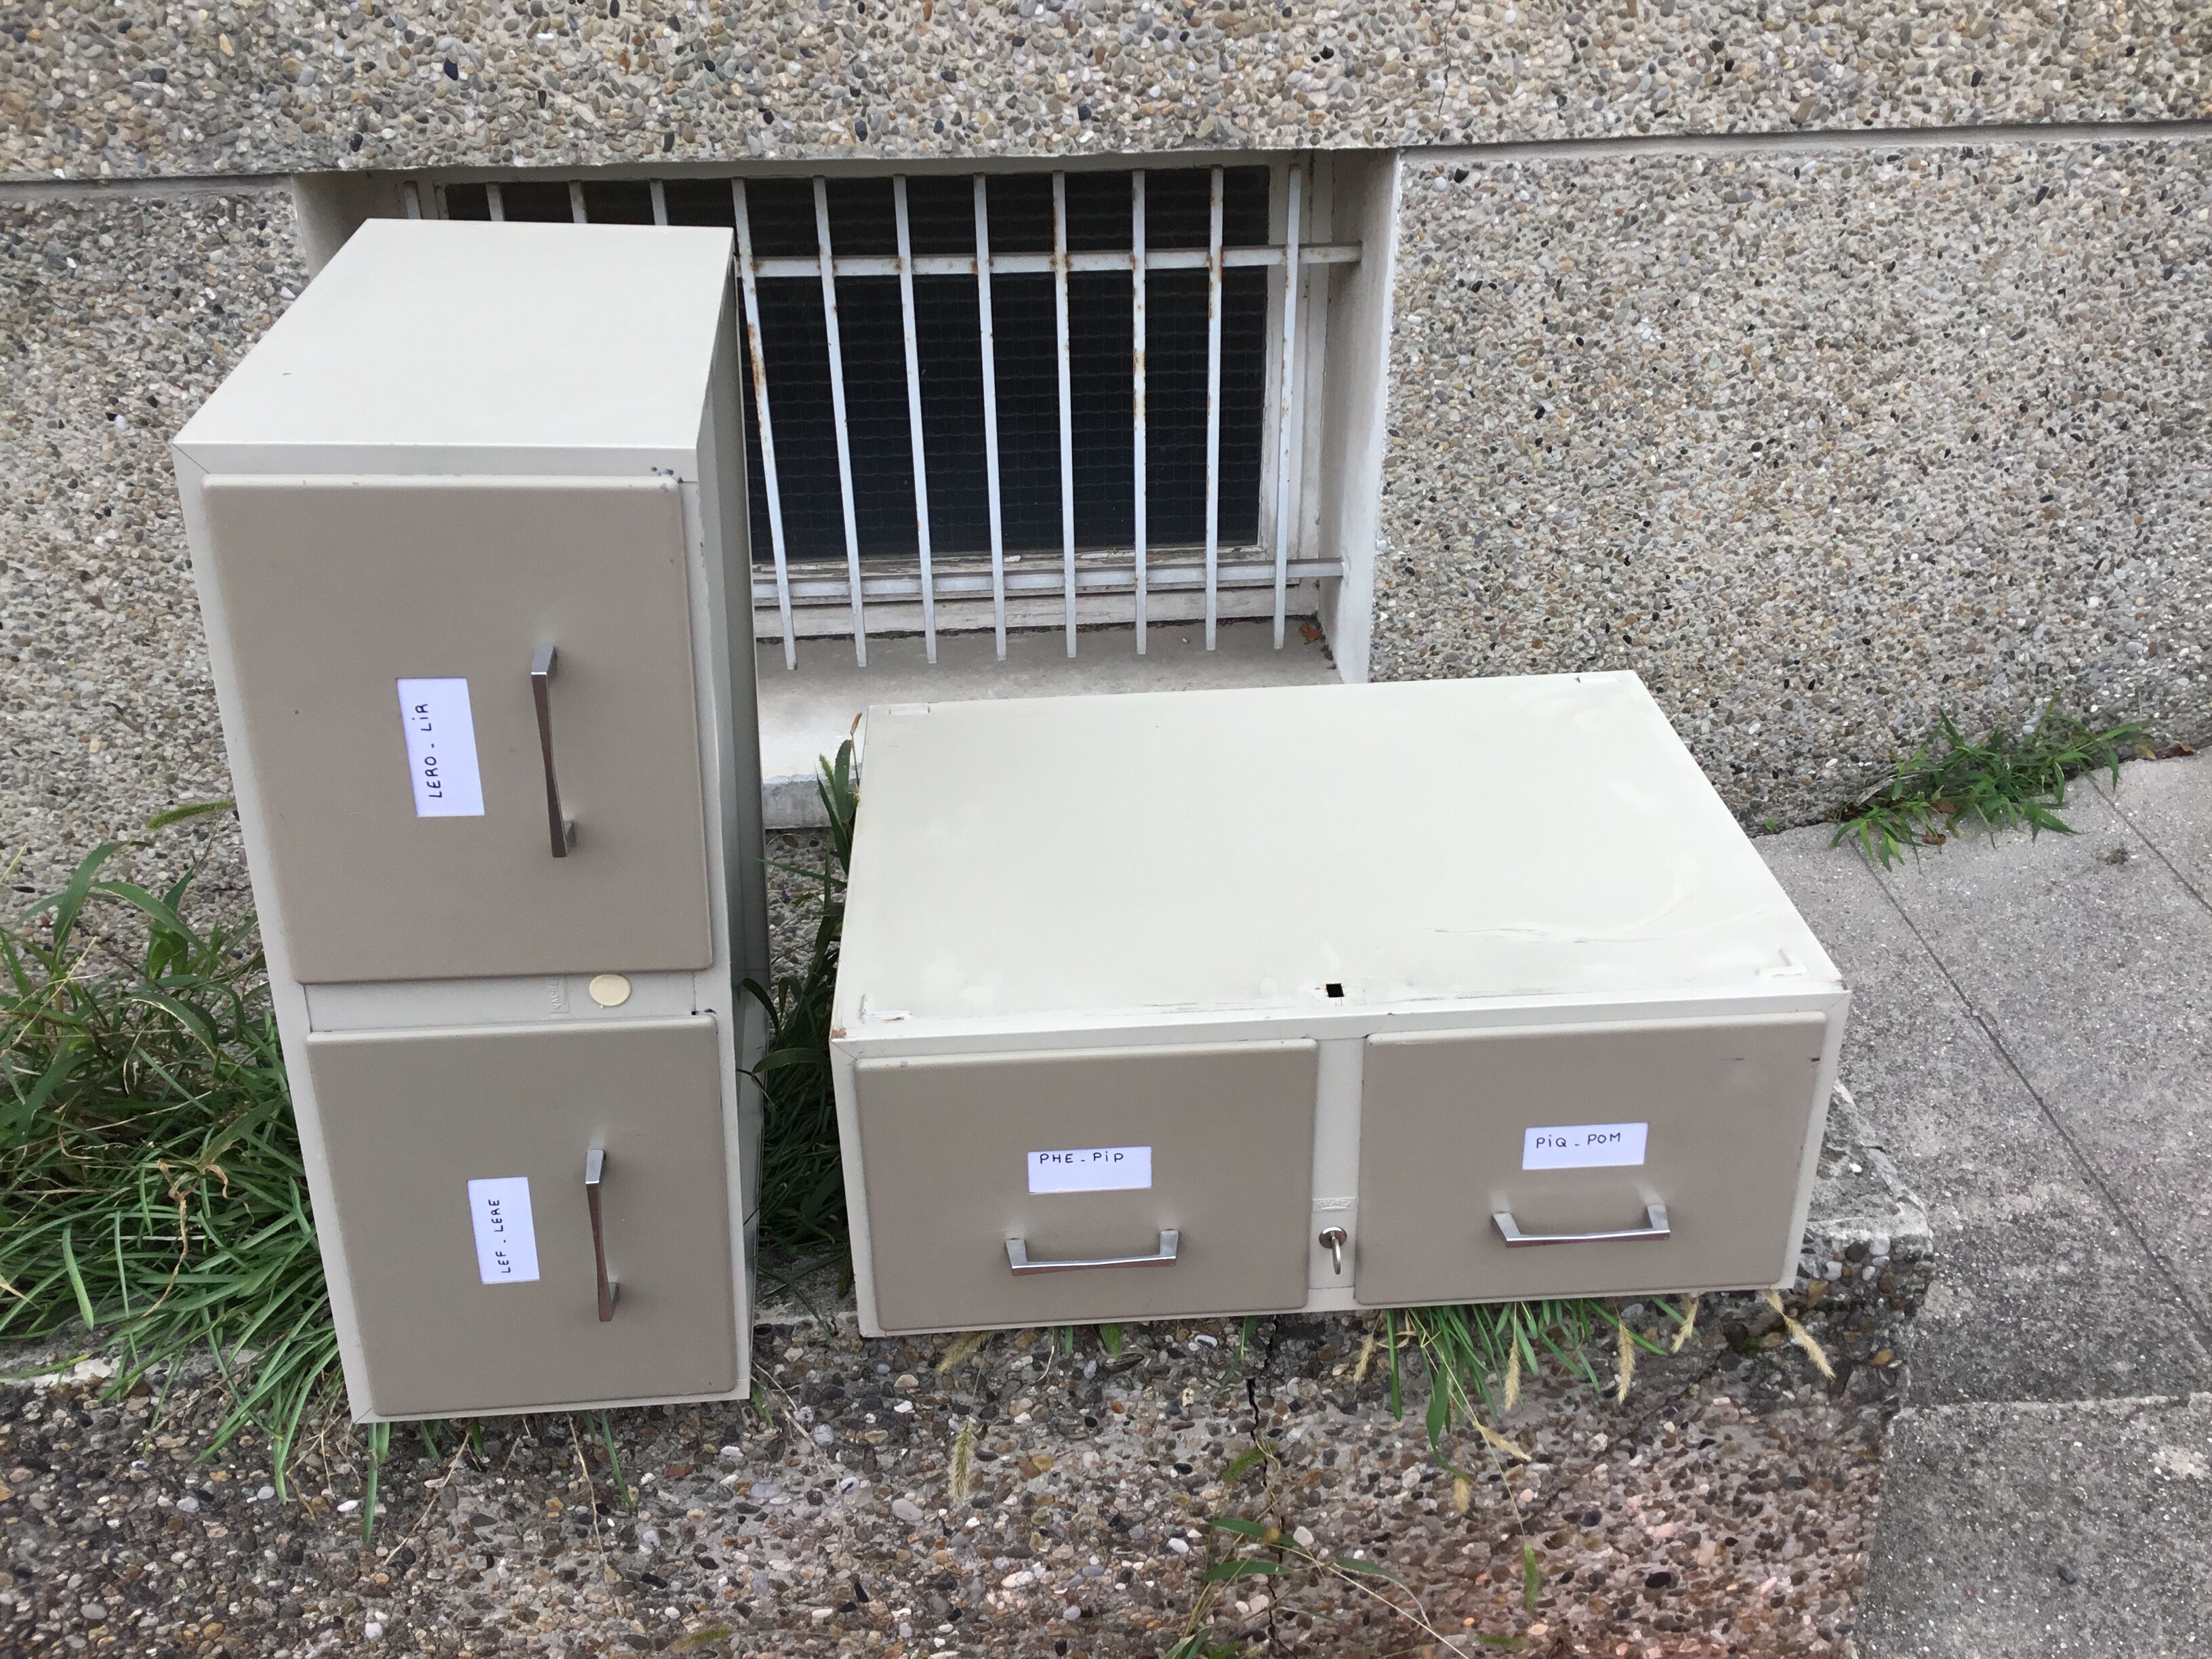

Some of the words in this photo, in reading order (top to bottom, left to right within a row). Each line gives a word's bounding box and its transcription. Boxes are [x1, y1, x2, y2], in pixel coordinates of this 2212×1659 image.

[424, 755, 443, 798] LERO
[1587, 1132, 1622, 1145] POM
[1039, 1153, 1074, 1165] PHE
[487, 1199, 504, 1232] LERE
[495, 1250, 511, 1273] LEF
